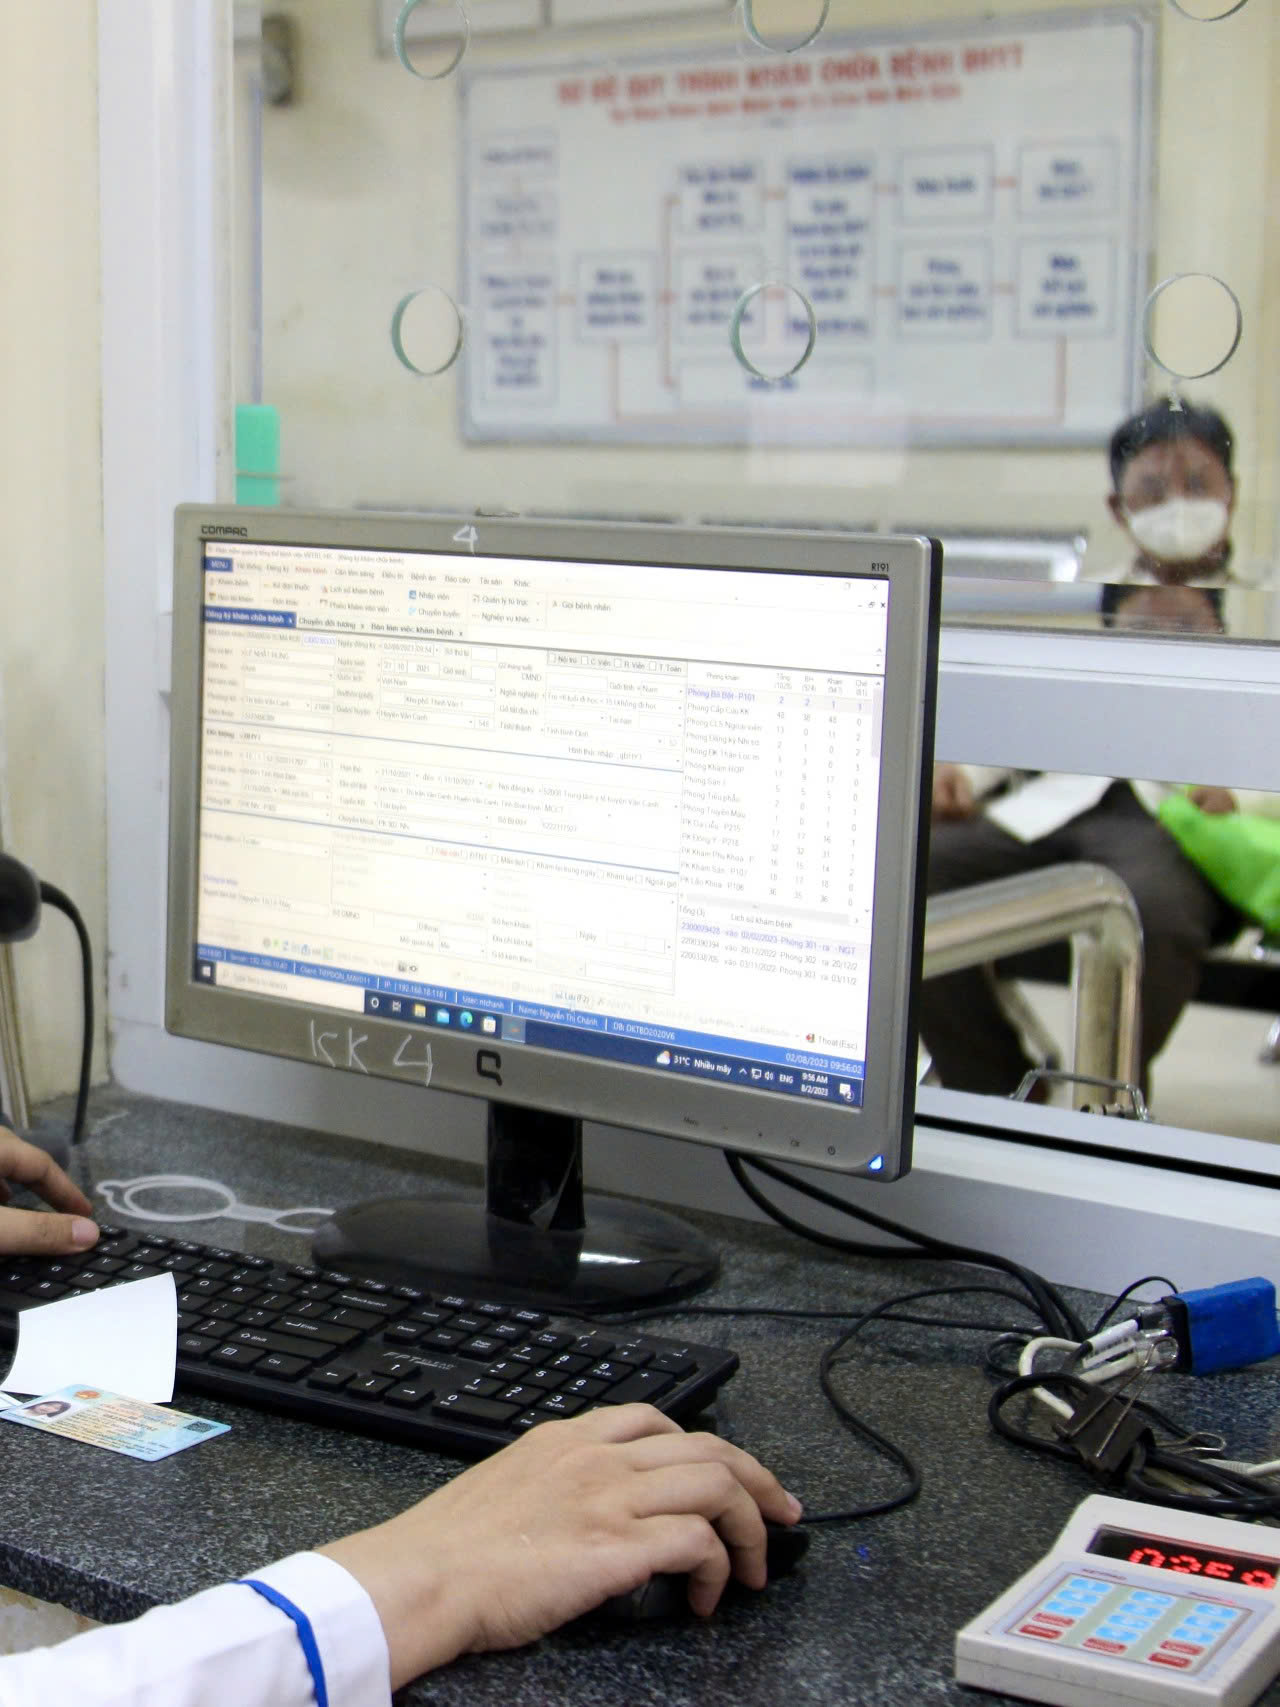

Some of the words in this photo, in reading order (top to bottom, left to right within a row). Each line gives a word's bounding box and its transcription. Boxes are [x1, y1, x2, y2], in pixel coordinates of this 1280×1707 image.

[453, 525, 477, 556] 4
[871, 563, 889, 572] R191
[393, 1034, 433, 1087] 4
[785, 1052, 828, 1068] 02/08/2023
[830, 1060, 862, 1074] 09:56:02
[694, 1058, 715, 1072] Nhiều
[716, 1062, 732, 1075] mây
[779, 1073, 793, 1083] ENG
[802, 1072, 815, 1082] 9:56
[815, 1074, 828, 1084] AM
[800, 1083, 828, 1097] 8/2/2023
[521, 1346, 532, 1354] 7
[496, 1362, 507, 1370] 4
[599, 1362, 610, 1371] 9
[536, 1369, 547, 1378] 5
[576, 1378, 587, 1387] 6
[447, 1393, 458, 1402] 0
[552, 1394, 563, 1403] 3
